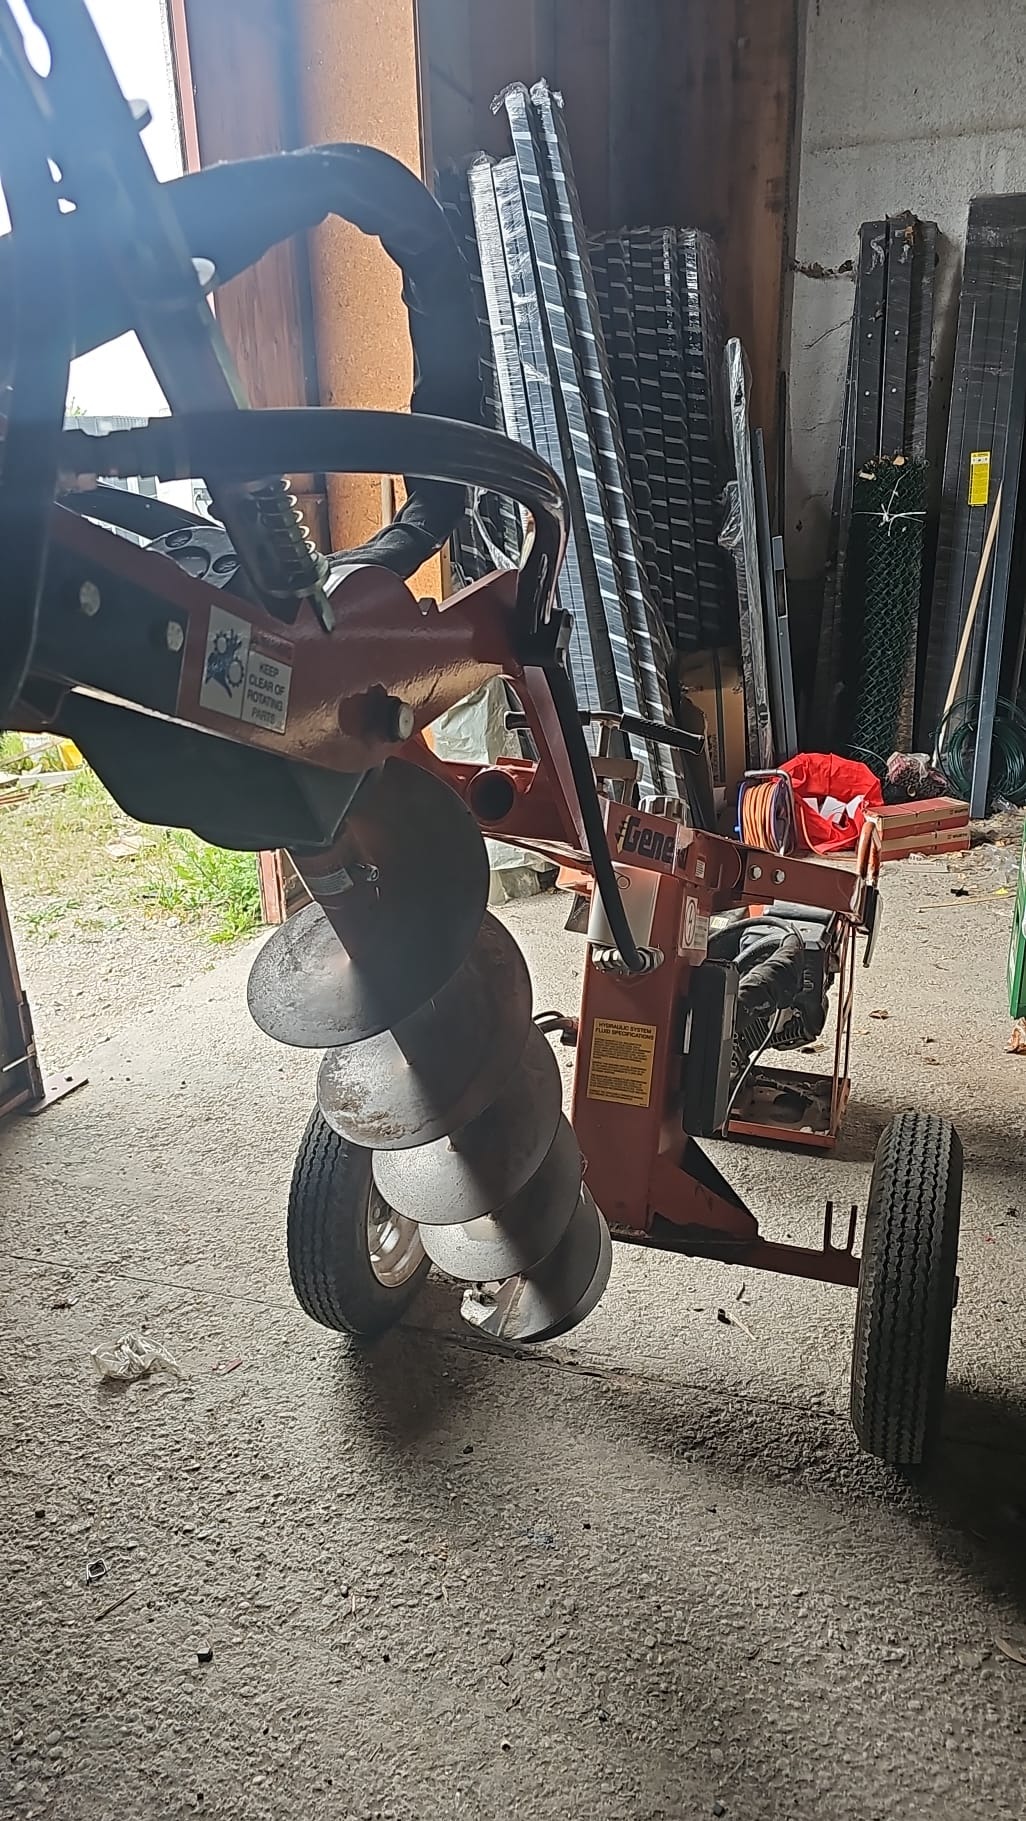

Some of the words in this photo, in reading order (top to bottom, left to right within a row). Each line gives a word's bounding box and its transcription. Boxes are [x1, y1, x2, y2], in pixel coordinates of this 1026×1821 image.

[260, 664, 279, 678] KEEP
[249, 674, 274, 693] CLEAR
[275, 684, 285, 695] OF
[247, 688, 283, 712] ROTATING
[252, 707, 275, 724] PARTS
[599, 1023, 629, 1031] HYDRAULIC
[630, 1025, 651, 1034] SYSTEM
[612, 1029, 654, 1040] SPECIFICATIONS
